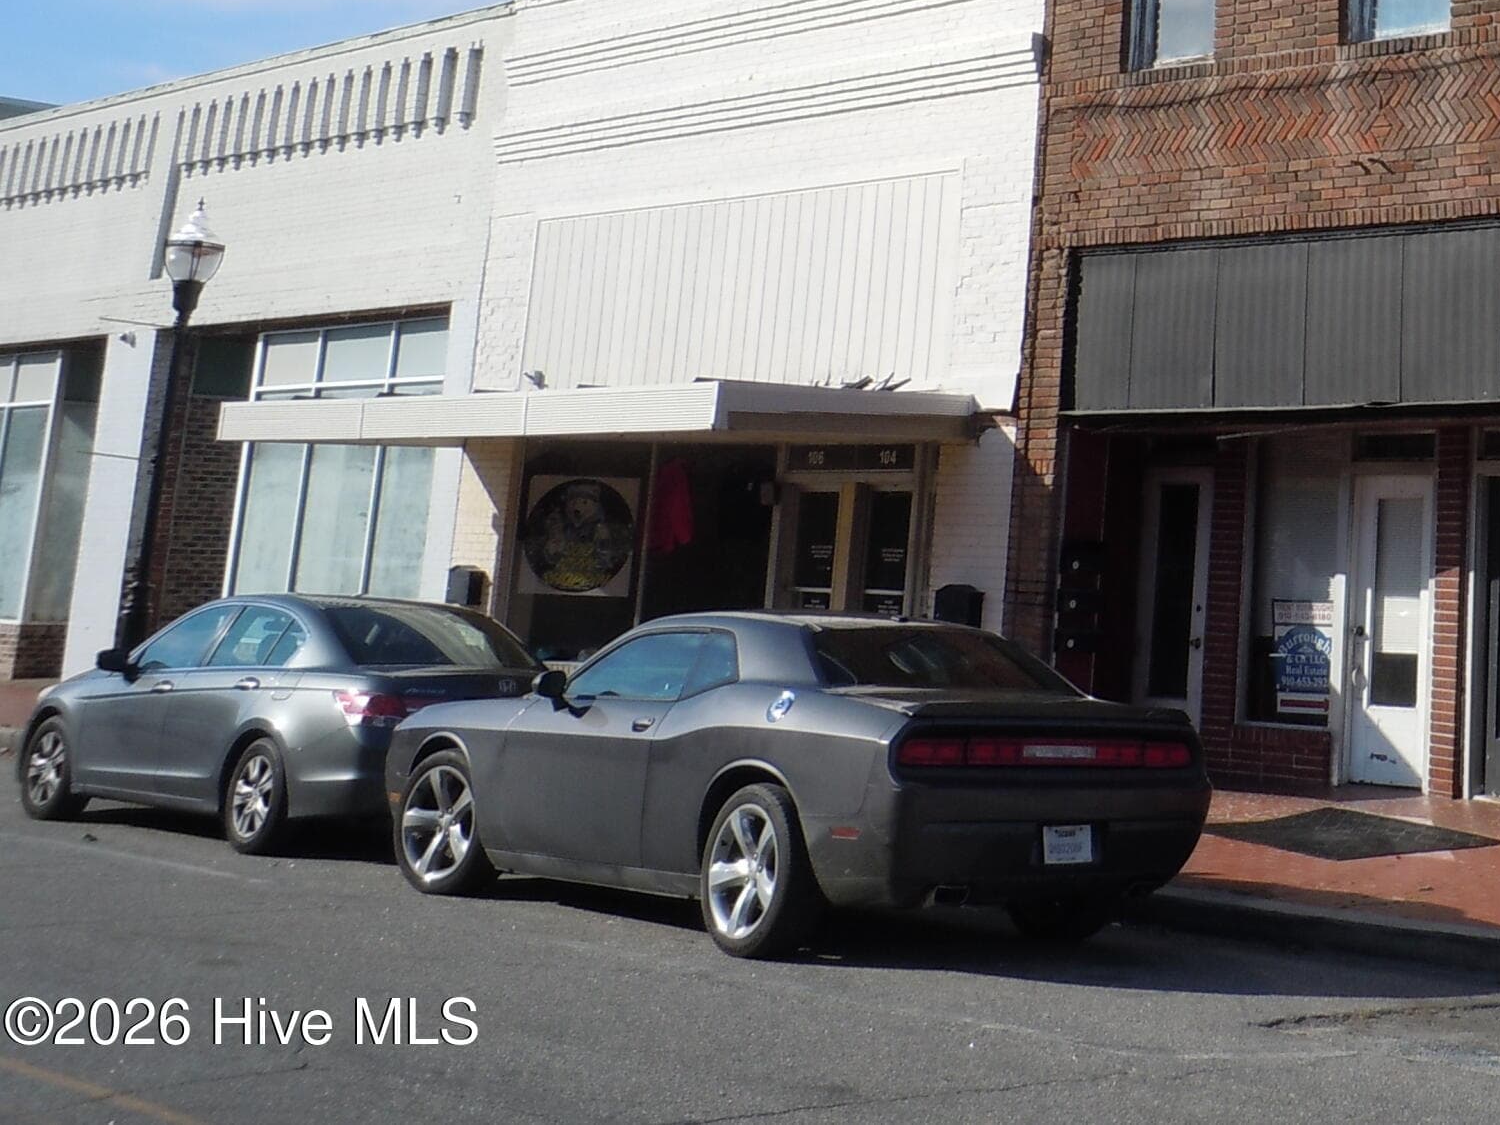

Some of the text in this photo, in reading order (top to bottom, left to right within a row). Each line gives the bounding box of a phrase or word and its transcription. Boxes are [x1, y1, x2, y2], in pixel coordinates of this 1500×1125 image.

[880, 450, 897, 465] 104
[1310, 654, 1326, 664] LLC
[1286, 665, 1328, 676] Real Estate
